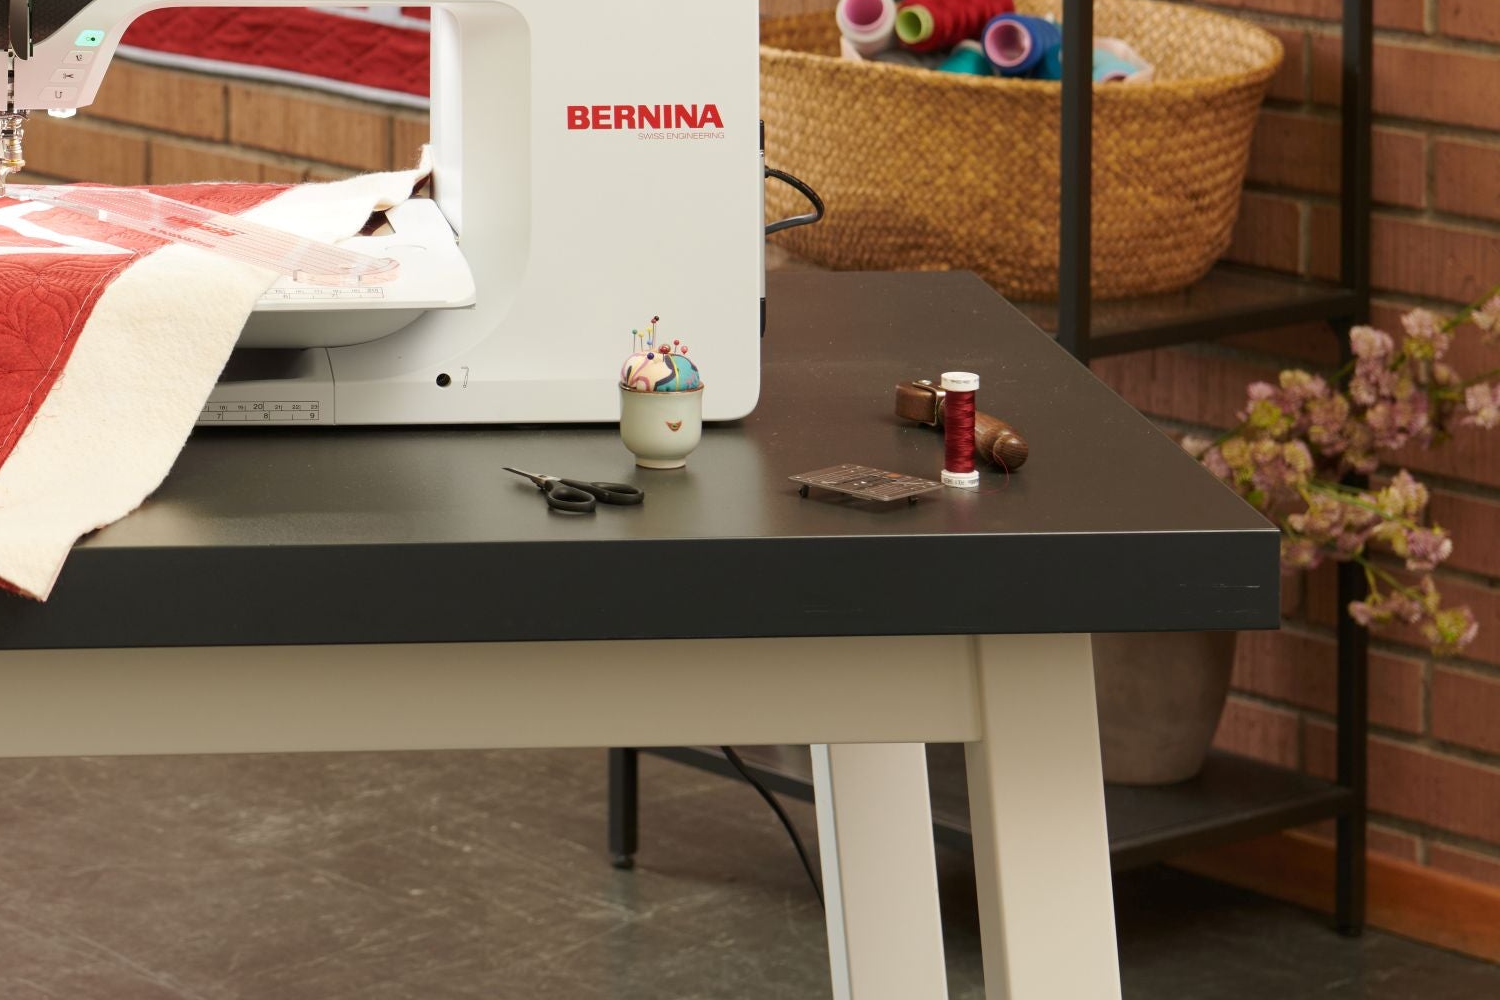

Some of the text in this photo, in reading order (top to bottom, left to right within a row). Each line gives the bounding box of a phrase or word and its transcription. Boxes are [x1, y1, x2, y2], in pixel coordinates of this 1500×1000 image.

[567, 104, 725, 130] BERNINA
[637, 132, 725, 140] SWISS ENGINEERING
